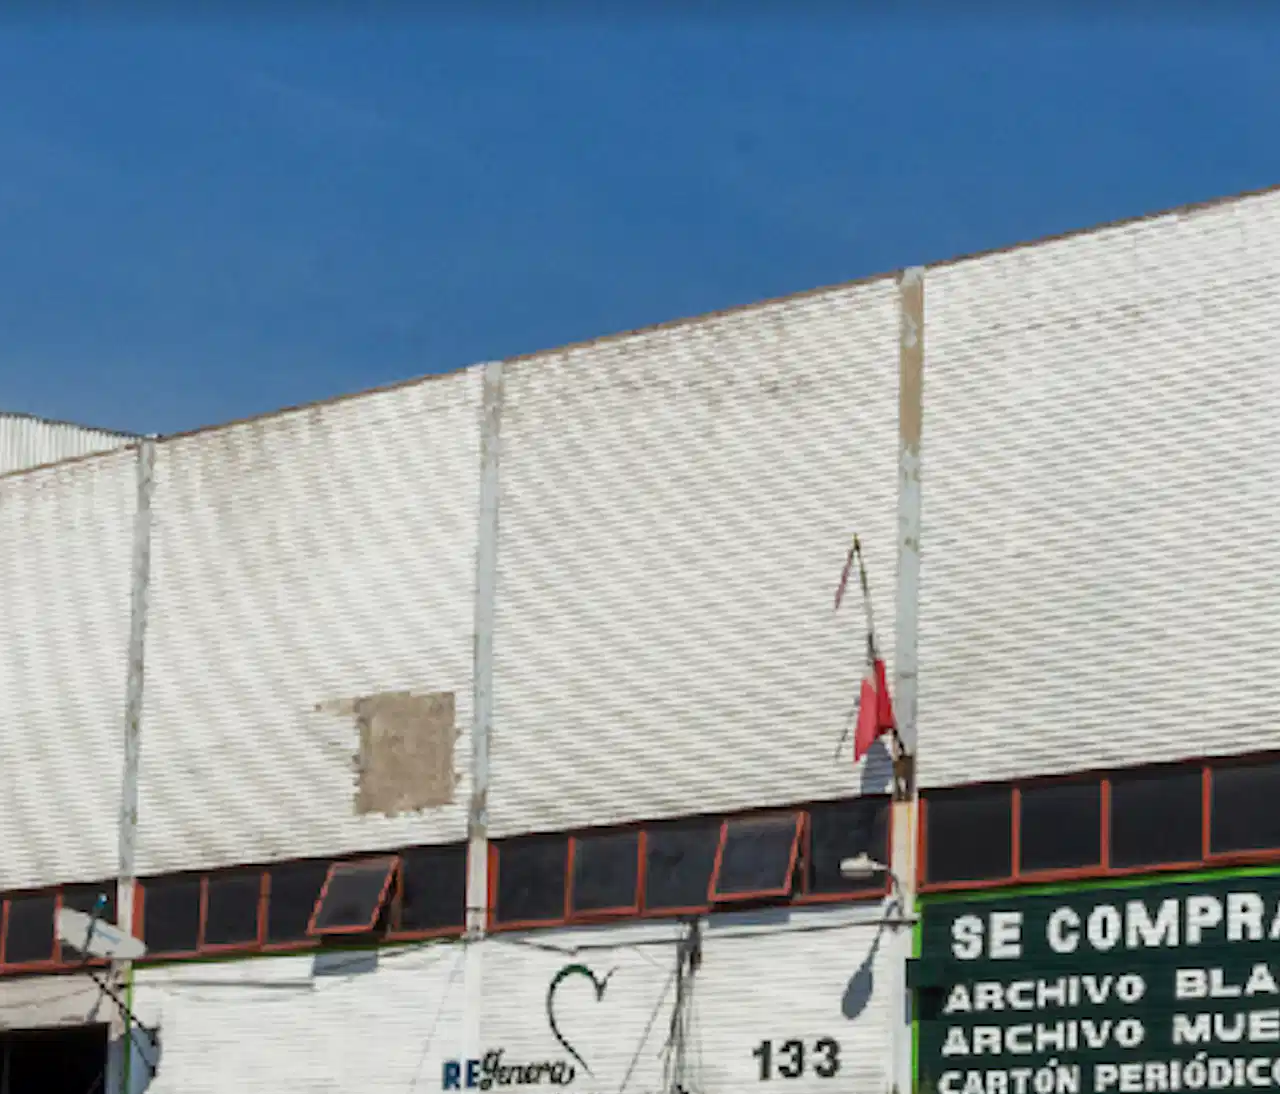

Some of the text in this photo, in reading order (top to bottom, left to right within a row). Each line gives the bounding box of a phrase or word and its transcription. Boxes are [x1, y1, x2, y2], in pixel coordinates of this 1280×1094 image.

[951, 912, 1023, 960] SE
[942, 974, 1147, 1014] ARCHIVO
[941, 1018, 1146, 1057] ARCHIVO
[753, 1037, 842, 1080] 133
